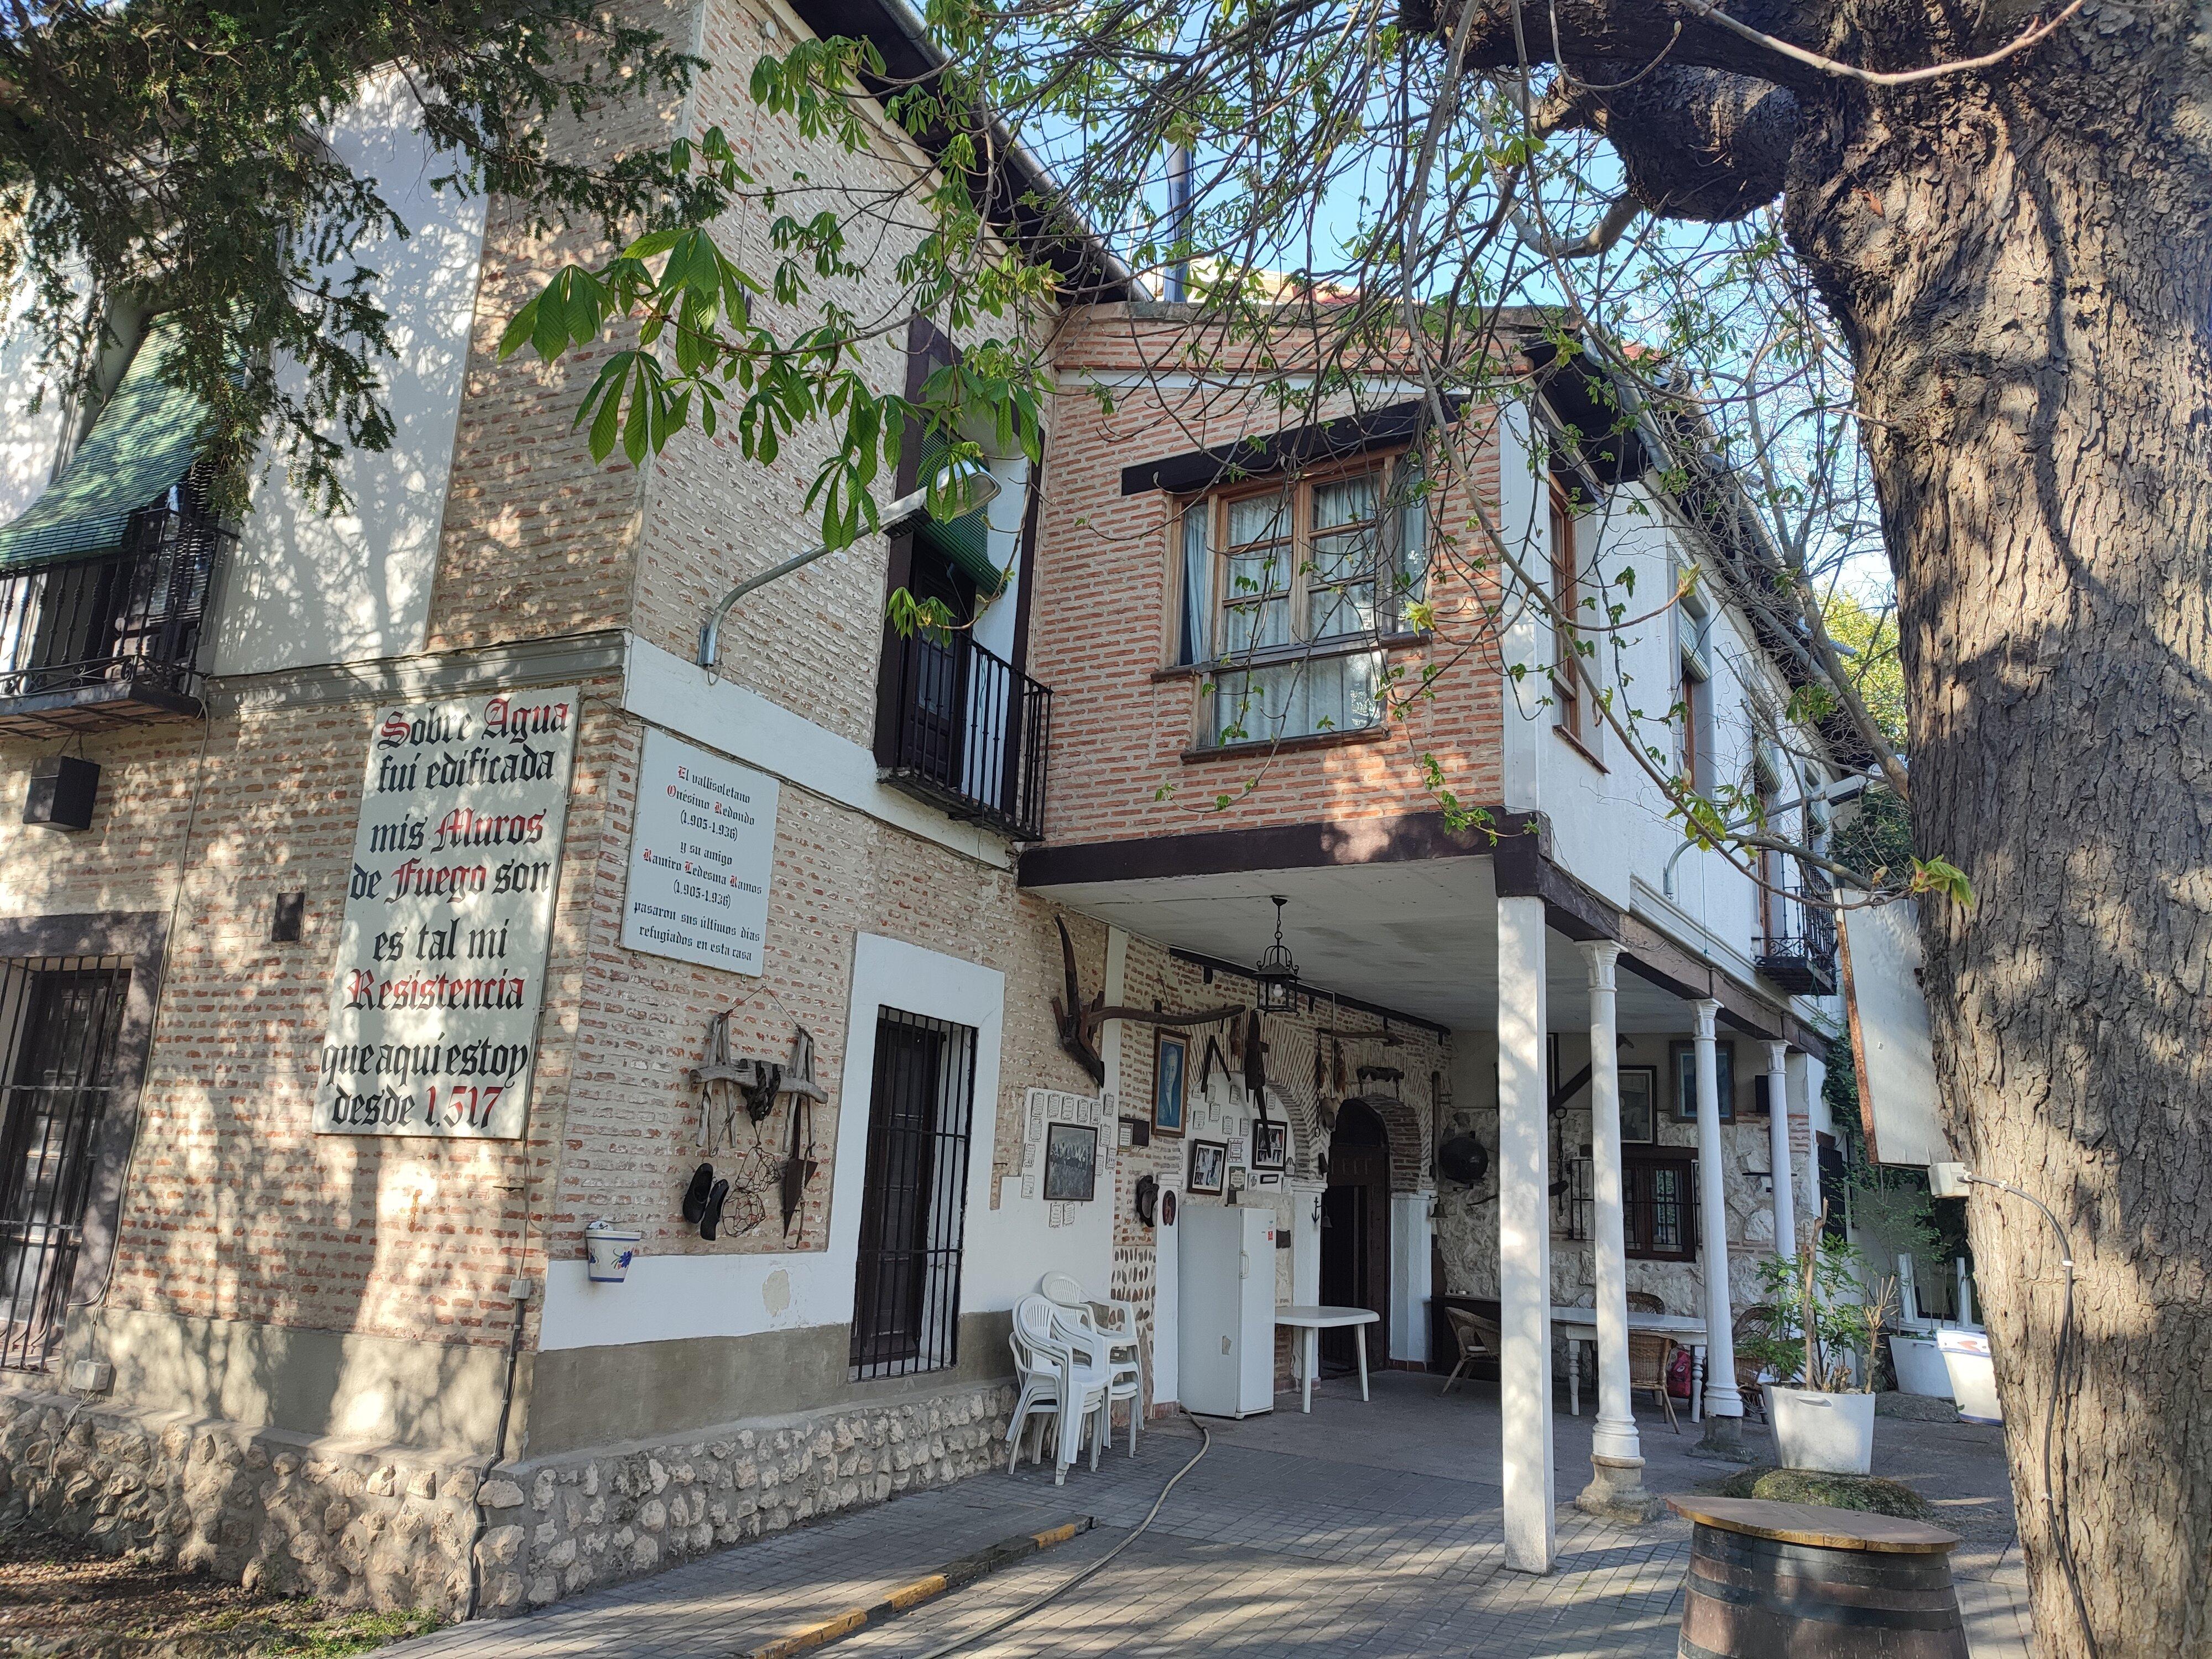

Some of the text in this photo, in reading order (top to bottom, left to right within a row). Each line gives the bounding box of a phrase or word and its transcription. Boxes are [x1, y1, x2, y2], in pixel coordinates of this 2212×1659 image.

[377, 698, 570, 750] Sobre Agua
[425, 744, 556, 789] edificada
[677, 765, 750, 804] El vallisoletano
[667, 784, 755, 826] Onésimo Redondo
[680, 809, 738, 842] (1.905-1.936)
[369, 807, 547, 855] mis Muros
[643, 848, 762, 895] Ramiro Ledesma Ramos
[680, 841, 733, 867] y su amigo
[349, 857, 552, 905] de Fuego son
[674, 879, 731, 910] (1.905-1.936)
[372, 917, 510, 962] es tal mi
[634, 901, 676, 921] pasaron
[681, 912, 698, 926] sus
[700, 916, 737, 936] últimos
[639, 925, 753, 962] refugiados en esta casa
[342, 968, 526, 1011] Resistencia
[321, 1043, 375, 1087] que
[445, 1036, 528, 1088] estoy
[331, 1084, 505, 1129] desde 1.517
